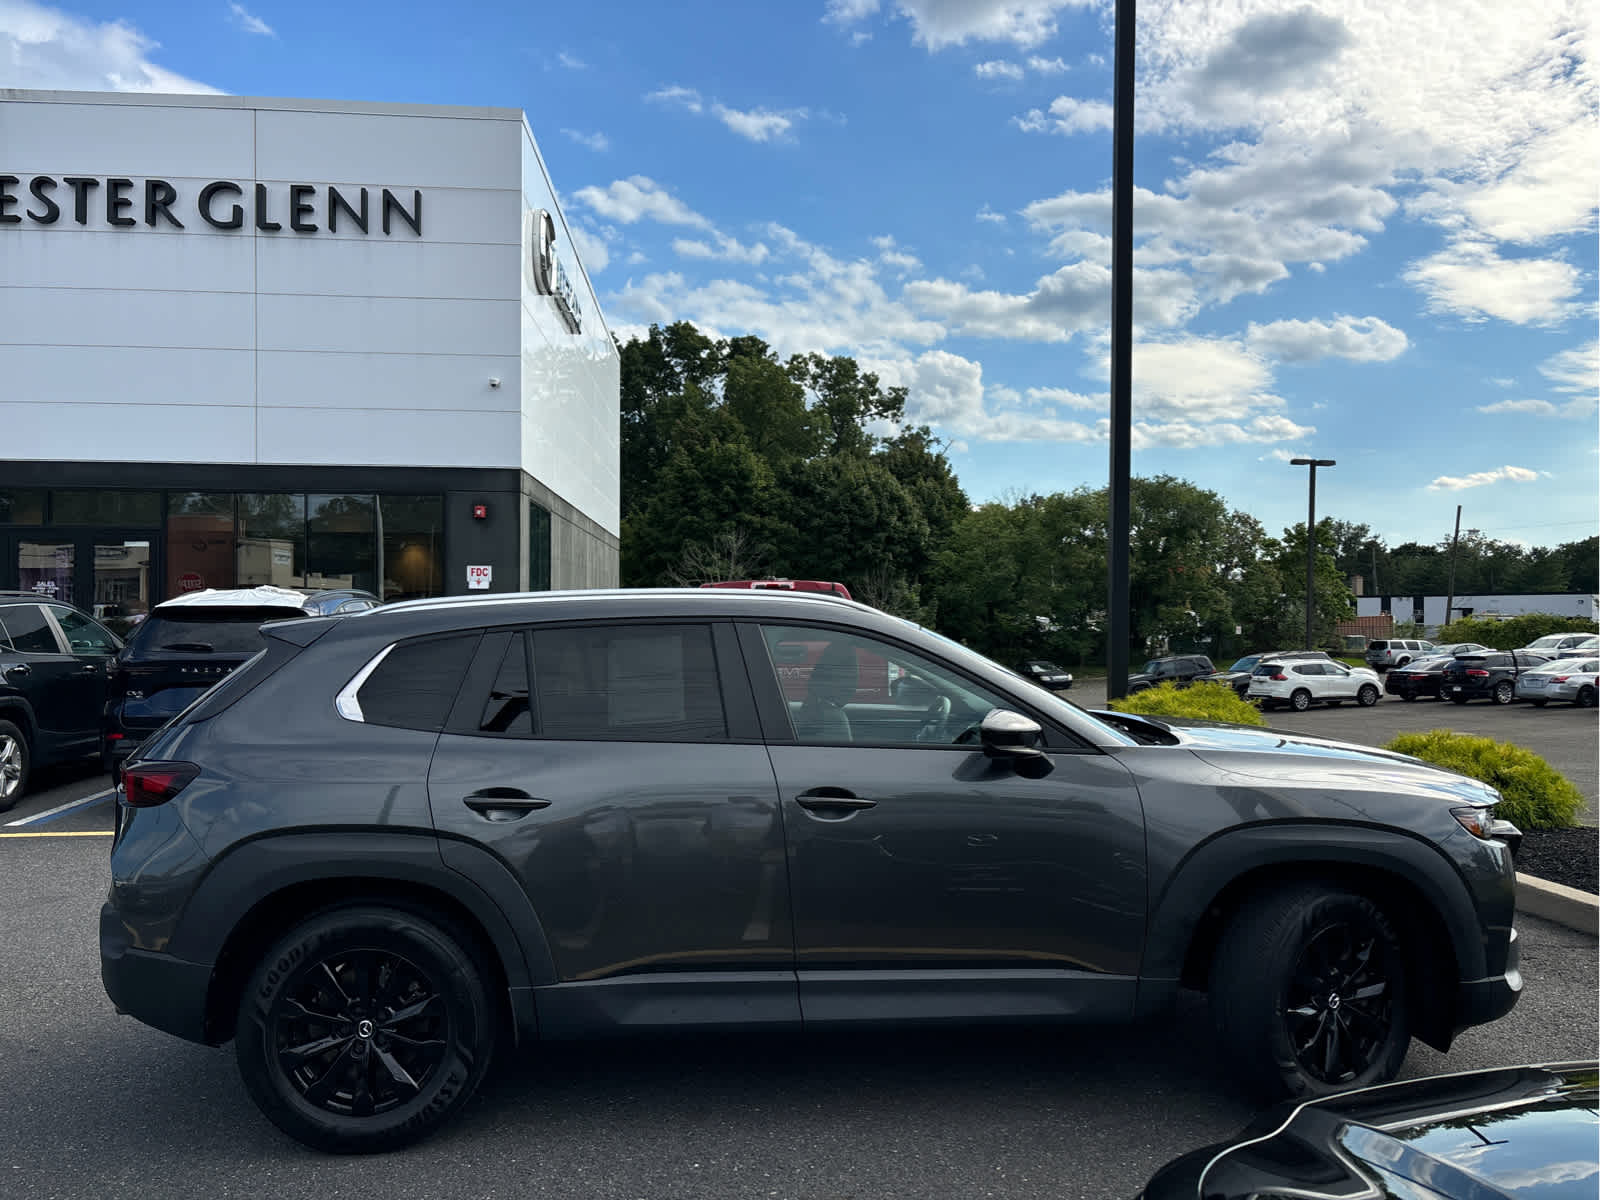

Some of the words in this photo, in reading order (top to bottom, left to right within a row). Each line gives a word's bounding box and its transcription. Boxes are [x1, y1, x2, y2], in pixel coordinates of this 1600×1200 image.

[0, 175, 185, 229] ESTER
[198, 180, 422, 237] GLENN
[470, 567, 488, 577] FDC
